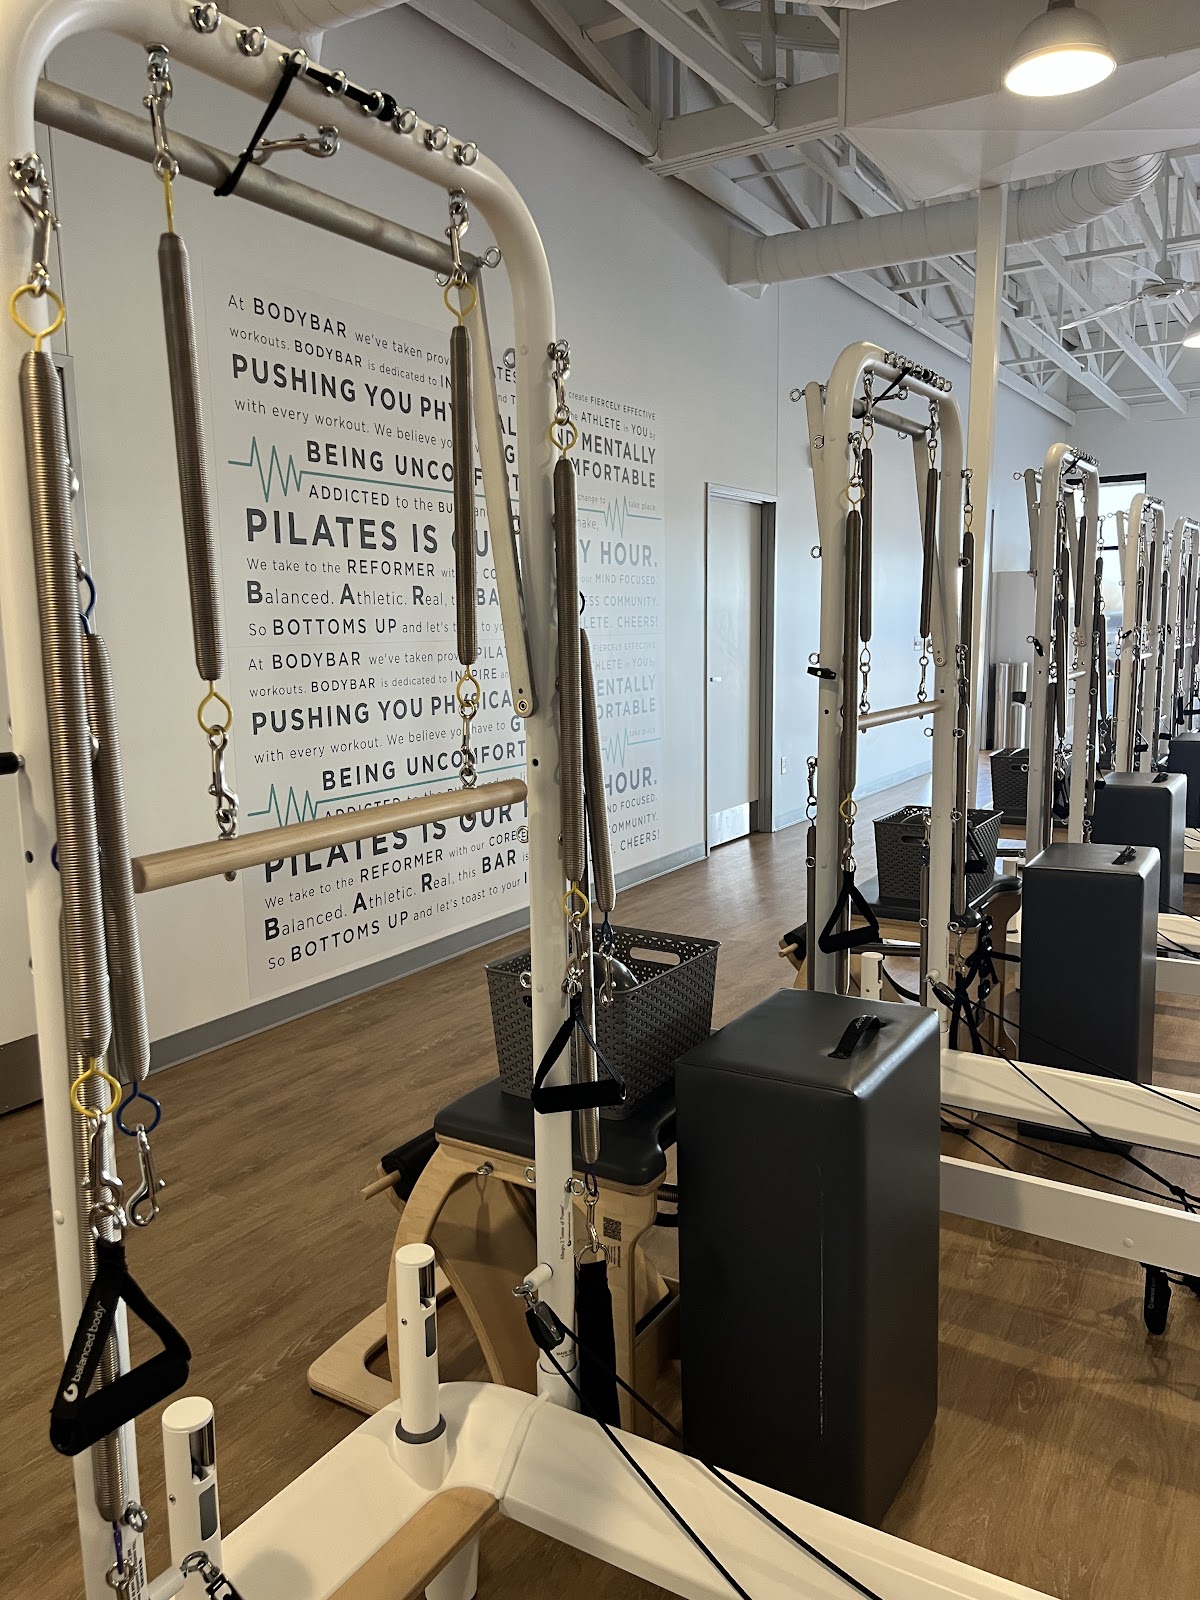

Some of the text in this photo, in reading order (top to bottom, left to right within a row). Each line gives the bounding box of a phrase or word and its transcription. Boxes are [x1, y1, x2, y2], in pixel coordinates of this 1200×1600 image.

[228, 295, 245, 311] At
[253, 297, 347, 338] BODYBAR
[354, 332, 388, 349] we've
[392, 340, 423, 359] taken
[568, 391, 589, 403] create
[590, 395, 621, 412] FIERCELY
[623, 402, 656, 421] EFFECTIVE
[229, 327, 290, 351] workouts.
[294, 339, 362, 368] BODYBAR
[367, 359, 376, 371] is
[379, 363, 425, 383] dedicated
[428, 375, 438, 386] to
[580, 411, 621, 431] ATHLETE
[631, 423, 649, 438] YOU
[232, 353, 356, 402] PUSHING
[364, 383, 412, 414] YOU
[581, 431, 656, 466] MENTALLY
[234, 398, 266, 415] with
[272, 405, 309, 425] every
[314, 413, 370, 434] workout.
[374, 422, 392, 438] We
[397, 427, 437, 446] believe
[306, 439, 383, 472] BEING
[578, 493, 599, 504] change
[628, 500, 640, 510] take
[309, 484, 390, 507] ADDICTED
[396, 496, 409, 509] to
[414, 498, 434, 512] the
[246, 507, 398, 551] PILATES
[412, 523, 439, 554] IS
[600, 541, 658, 568] HOUR.
[246, 558, 267, 571] We
[272, 559, 300, 572] take
[305, 561, 318, 573] to
[322, 562, 341, 574] the
[347, 559, 436, 577] REFORMER
[595, 573, 617, 585] MIND
[246, 580, 335, 605] Balanced.
[339, 583, 407, 606] Athletic.
[248, 623, 267, 637] So
[272, 618, 367, 636] BOTTOMS
[375, 618, 398, 634] UP
[402, 621, 423, 634] and
[426, 622, 449, 634] let's
[481, 621, 491, 633] to
[617, 616, 659, 629] CHEERS!
[248, 659, 264, 672] At
[272, 651, 361, 670] BODYBAR
[368, 653, 401, 666] we've
[404, 651, 434, 664] taken
[249, 684, 307, 698] workouts.
[311, 677, 376, 693] BODYBAR
[381, 678, 389, 688] is
[391, 674, 436, 688] dedicated
[438, 675, 448, 685] to
[631, 657, 648, 669] YOU
[252, 702, 370, 736] PUSHING
[377, 697, 423, 722] YOU
[597, 673, 656, 697] ENTALLY
[254, 749, 285, 764] with
[289, 745, 326, 760] every
[330, 738, 382, 754] workout.
[386, 733, 405, 746] We
[408, 728, 447, 744] believe
[471, 723, 493, 735] have
[496, 721, 506, 732] to
[322, 760, 396, 791] BEING
[264, 895, 285, 909] We
[289, 887, 316, 903] take
[319, 883, 332, 895] to
[335, 877, 354, 890] the
[360, 848, 444, 883] REFORMER
[448, 844, 468, 858] with
[470, 841, 486, 853] our
[488, 830, 517, 847] CORE
[620, 793, 658, 811] FOCUSED.
[264, 904, 348, 941] Balanced.
[352, 886, 418, 914] Athletic.
[458, 867, 477, 882] this
[482, 849, 517, 874] BAR
[268, 828, 660, 970] So BOTTOMS UP and let's toast to your CHEERS!
[71, 1332, 96, 1383] balanced
